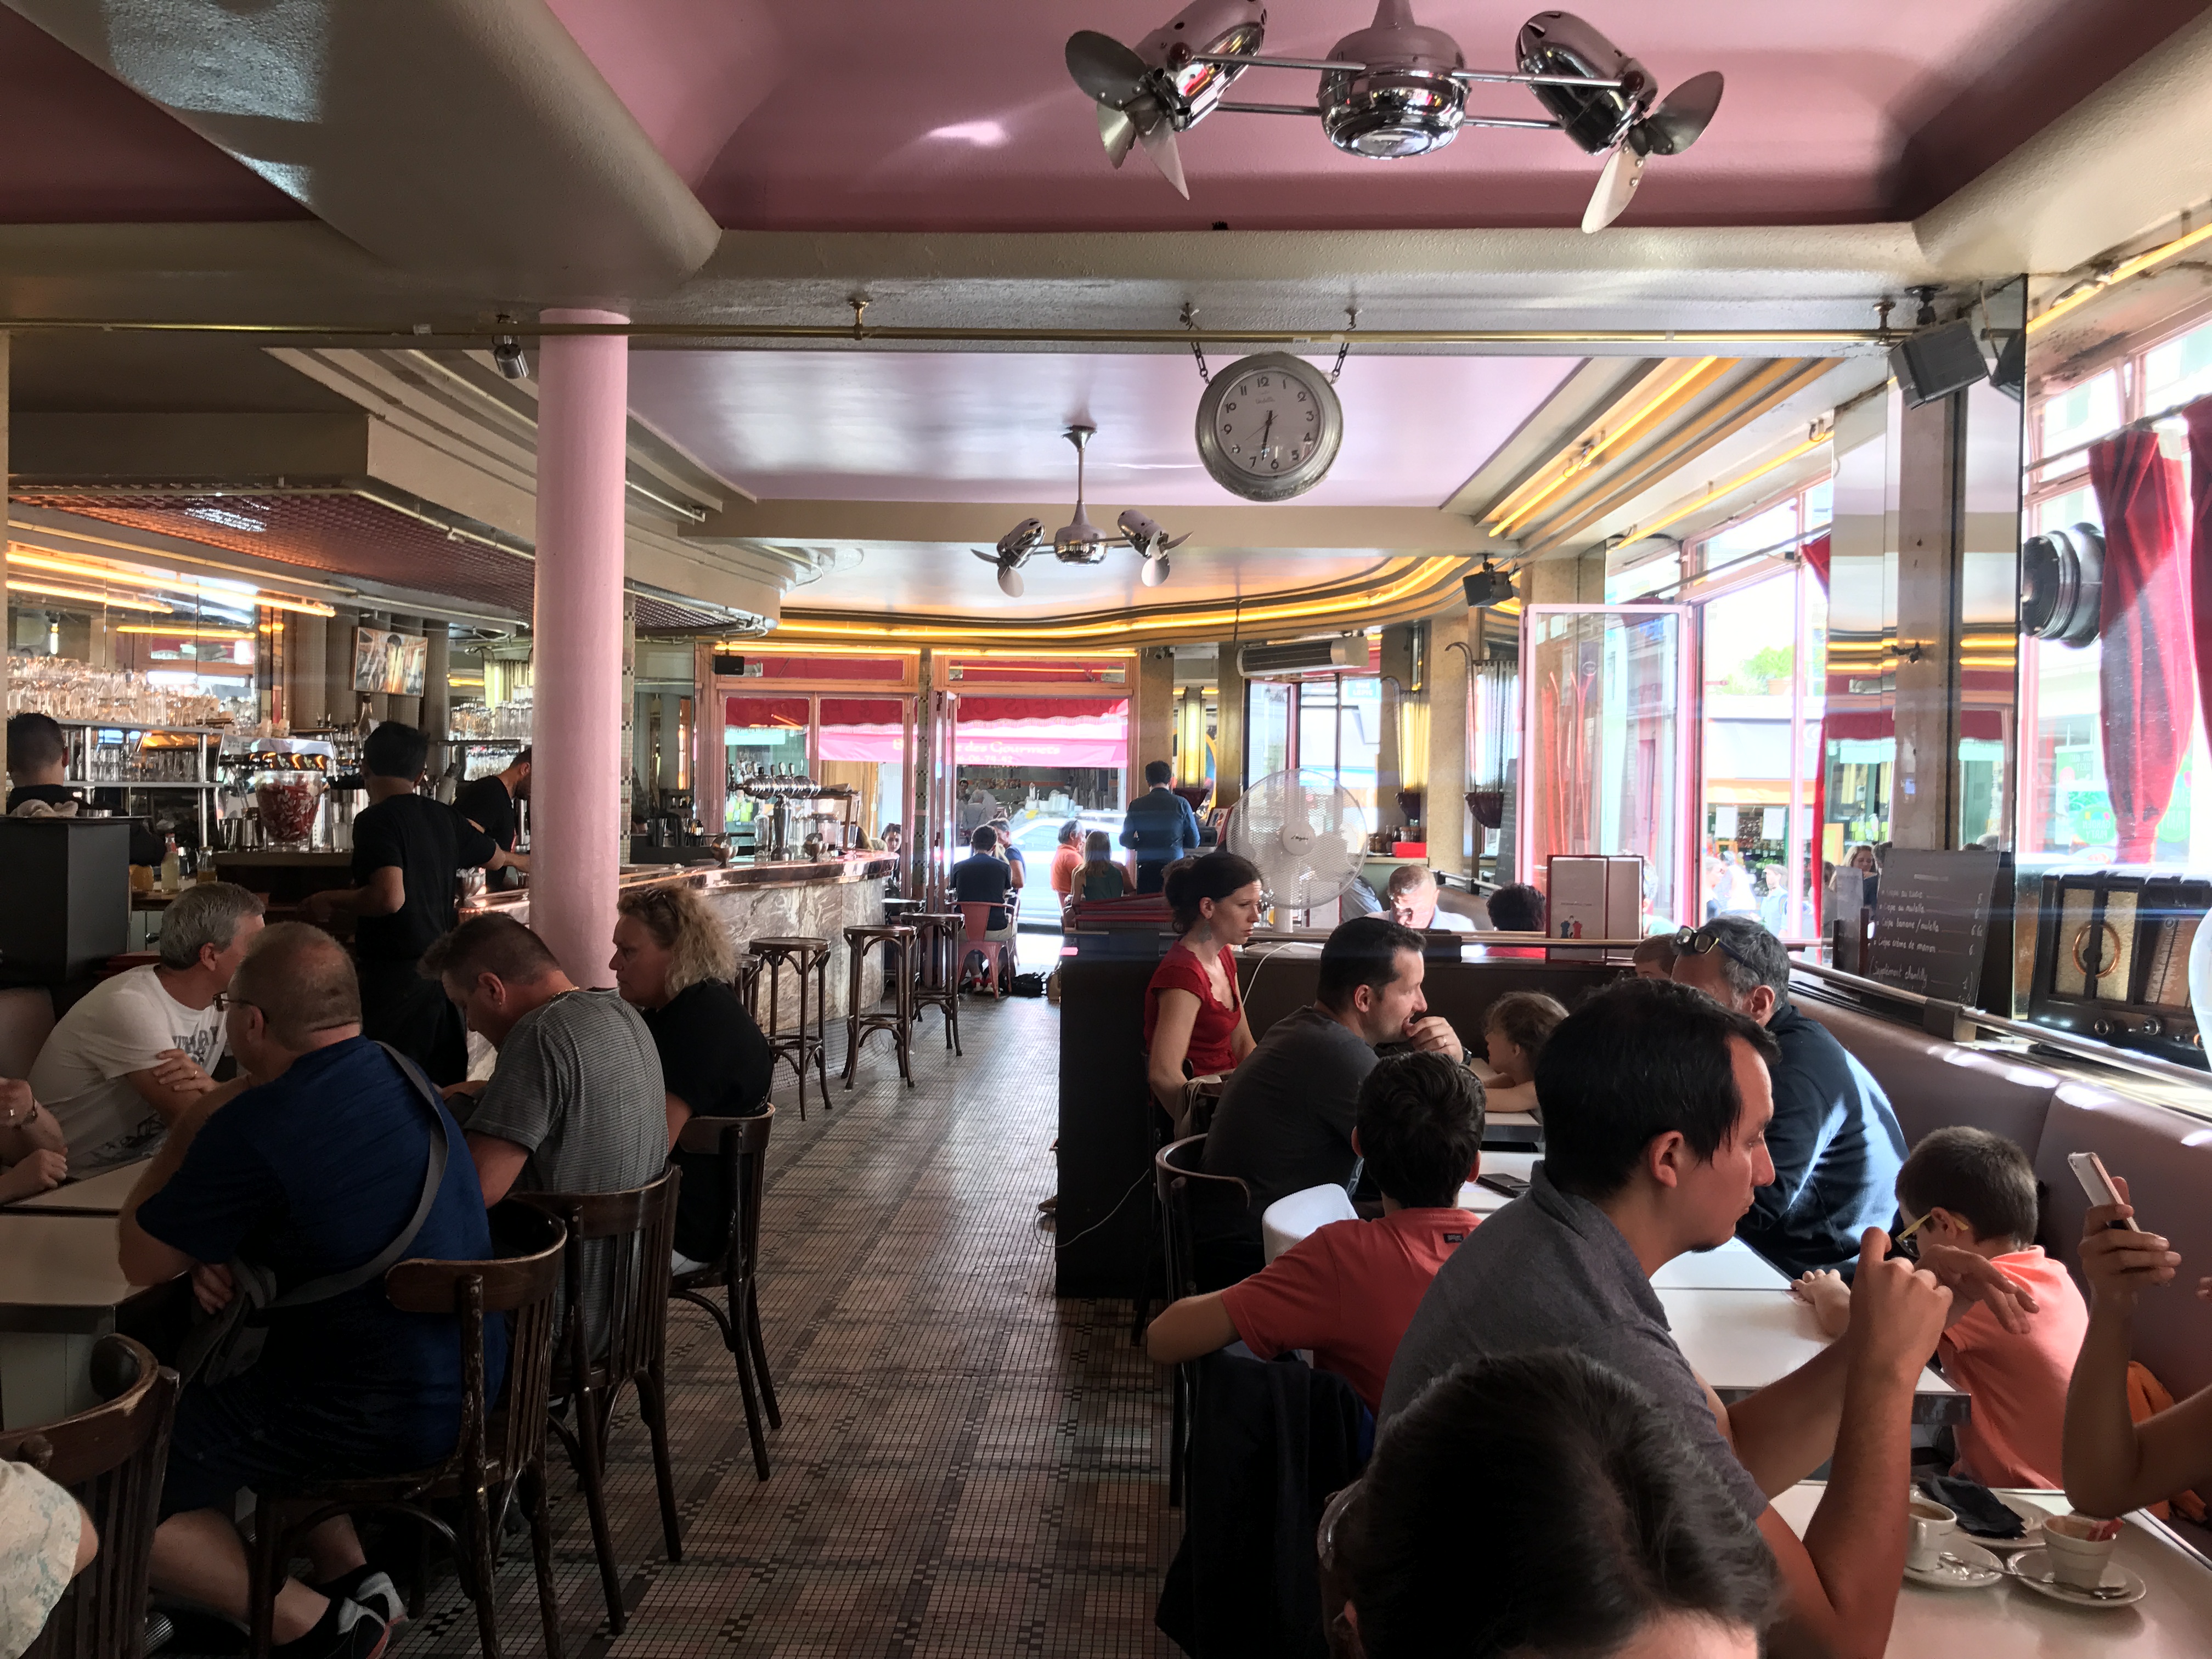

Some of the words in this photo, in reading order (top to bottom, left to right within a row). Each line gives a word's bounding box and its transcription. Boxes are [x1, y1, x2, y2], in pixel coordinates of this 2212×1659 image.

[1257, 376, 1270, 388] 12
[1240, 385, 1248, 396] 11
[1297, 391, 1307, 402] 2
[1225, 402, 1237, 414] 10
[1306, 410, 1314, 422] 3
[1223, 424, 1232, 435] 9
[1303, 432, 1313, 442] 4
[1291, 450, 1300, 461] 5
[1249, 456, 1257, 469] 7
[1271, 459, 1279, 470] 6
[965, 741, 987, 752] des
[990, 741, 1060, 755] Gourmets
